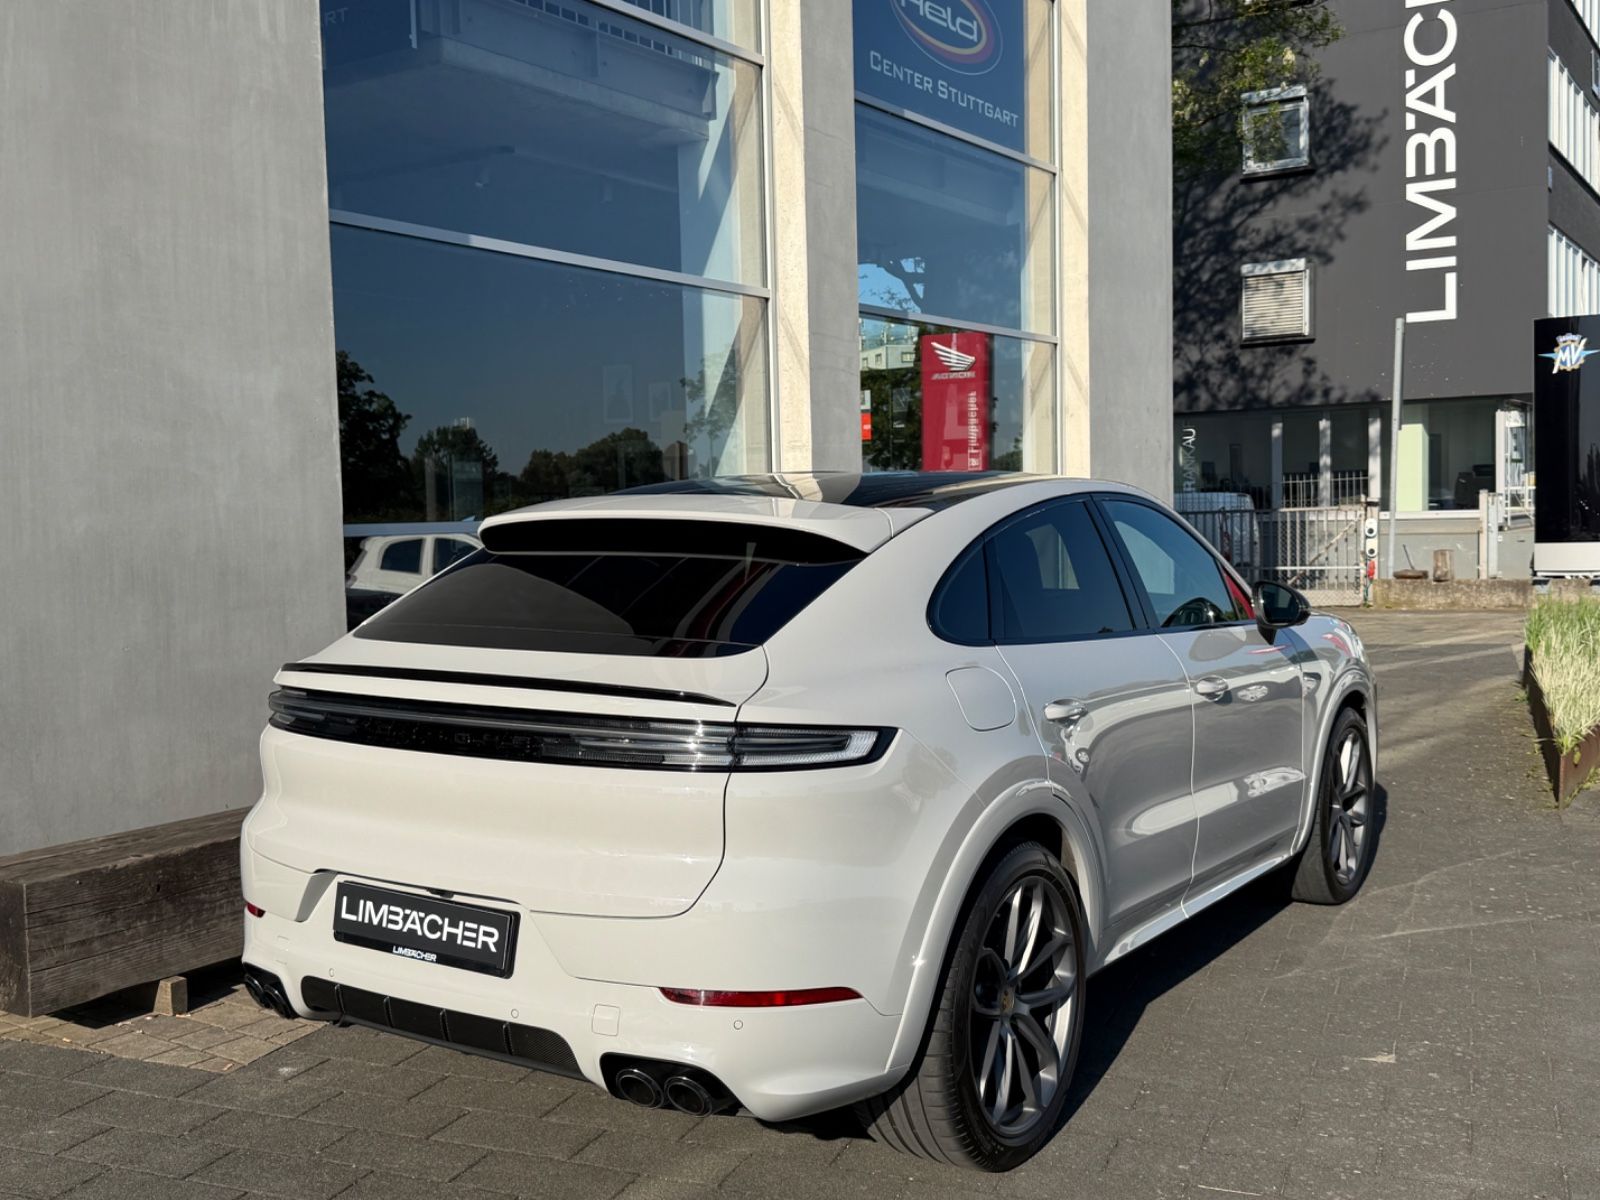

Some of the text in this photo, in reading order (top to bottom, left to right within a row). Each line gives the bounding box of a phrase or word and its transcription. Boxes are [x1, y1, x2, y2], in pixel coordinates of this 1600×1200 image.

[870, 50, 1020, 128] CENTER STUTTGART
[1403, 0, 1458, 323] LIMBÄC
[341, 896, 500, 953] LIMBÄCHER
